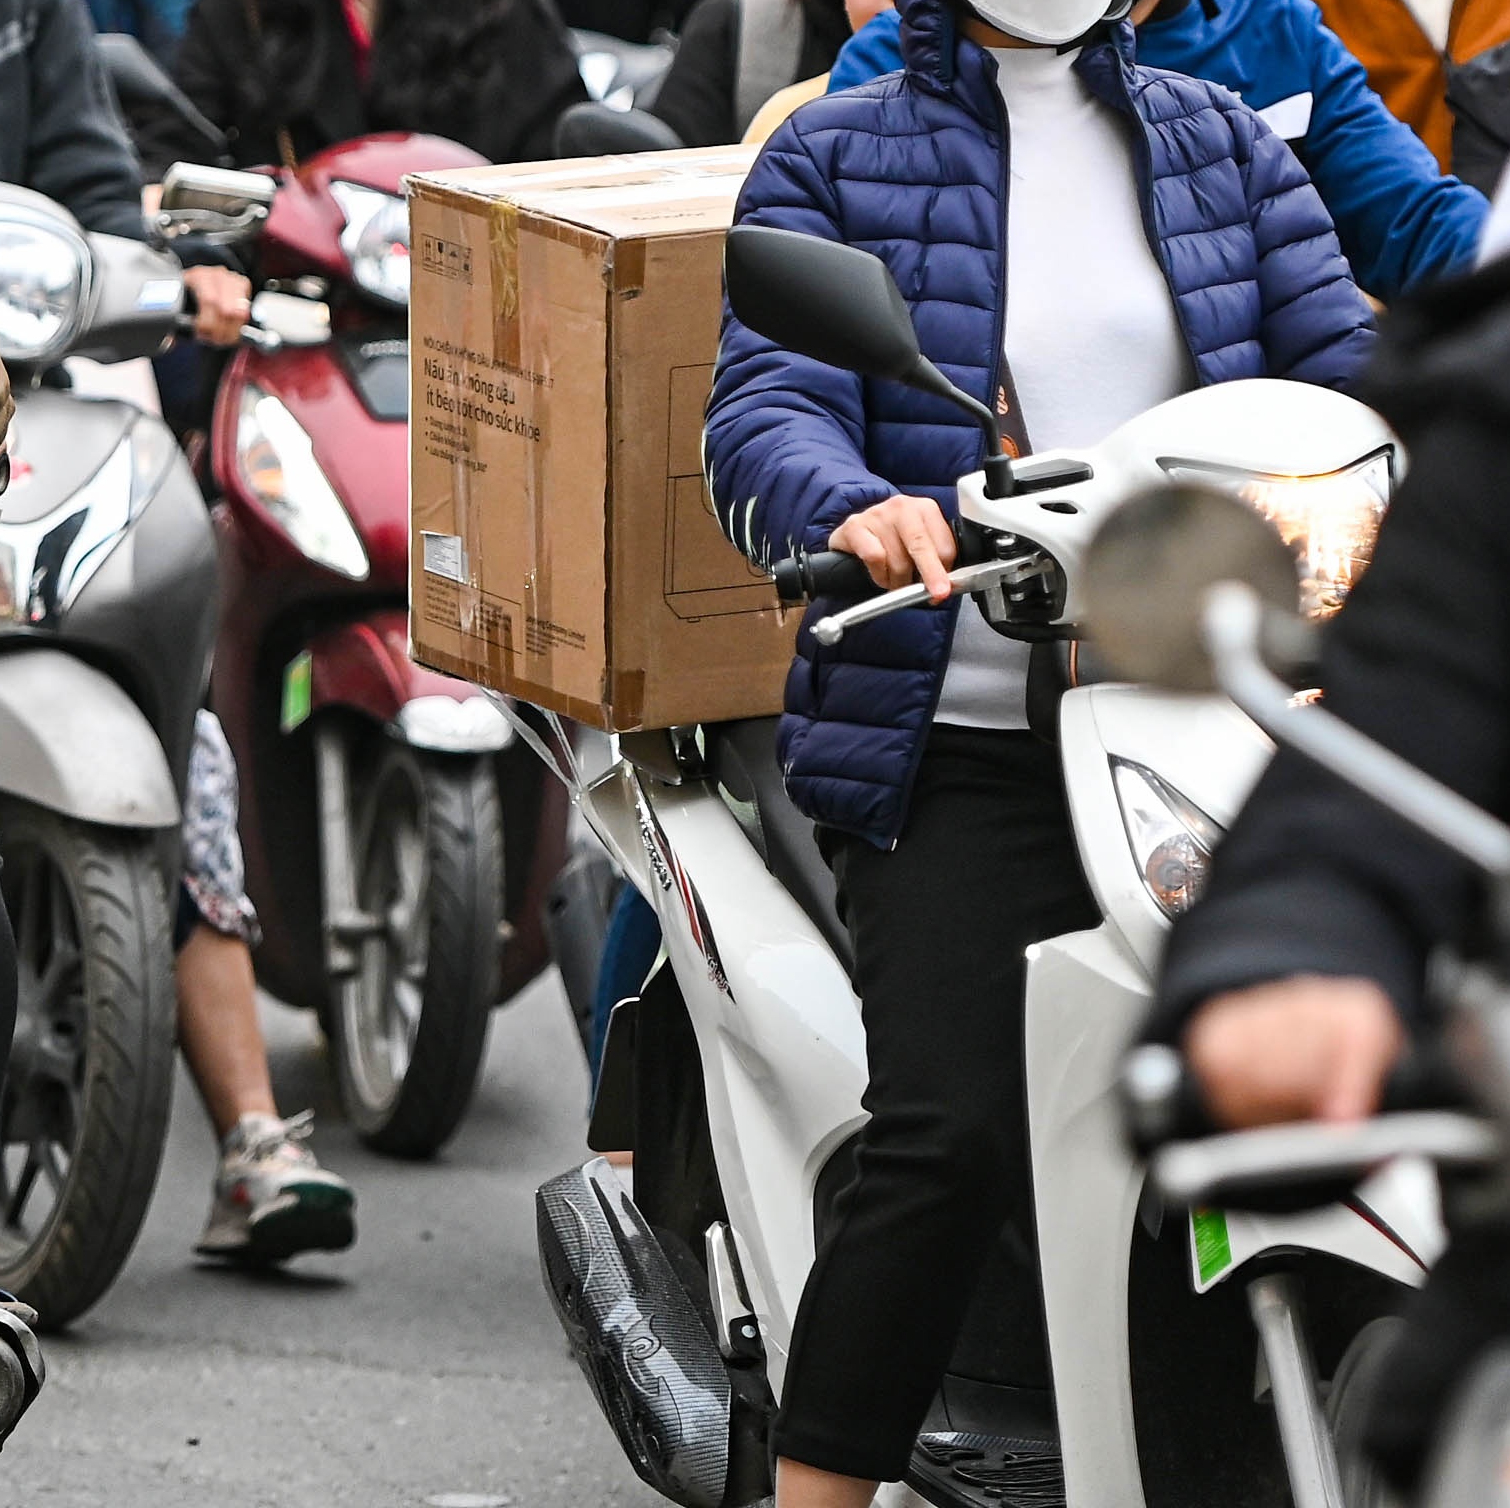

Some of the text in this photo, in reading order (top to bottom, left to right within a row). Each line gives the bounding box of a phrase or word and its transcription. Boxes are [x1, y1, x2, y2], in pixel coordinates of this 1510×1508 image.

[424, 358, 444, 380] Nấu
[474, 403, 494, 426] cho
[495, 409, 513, 433] sức
